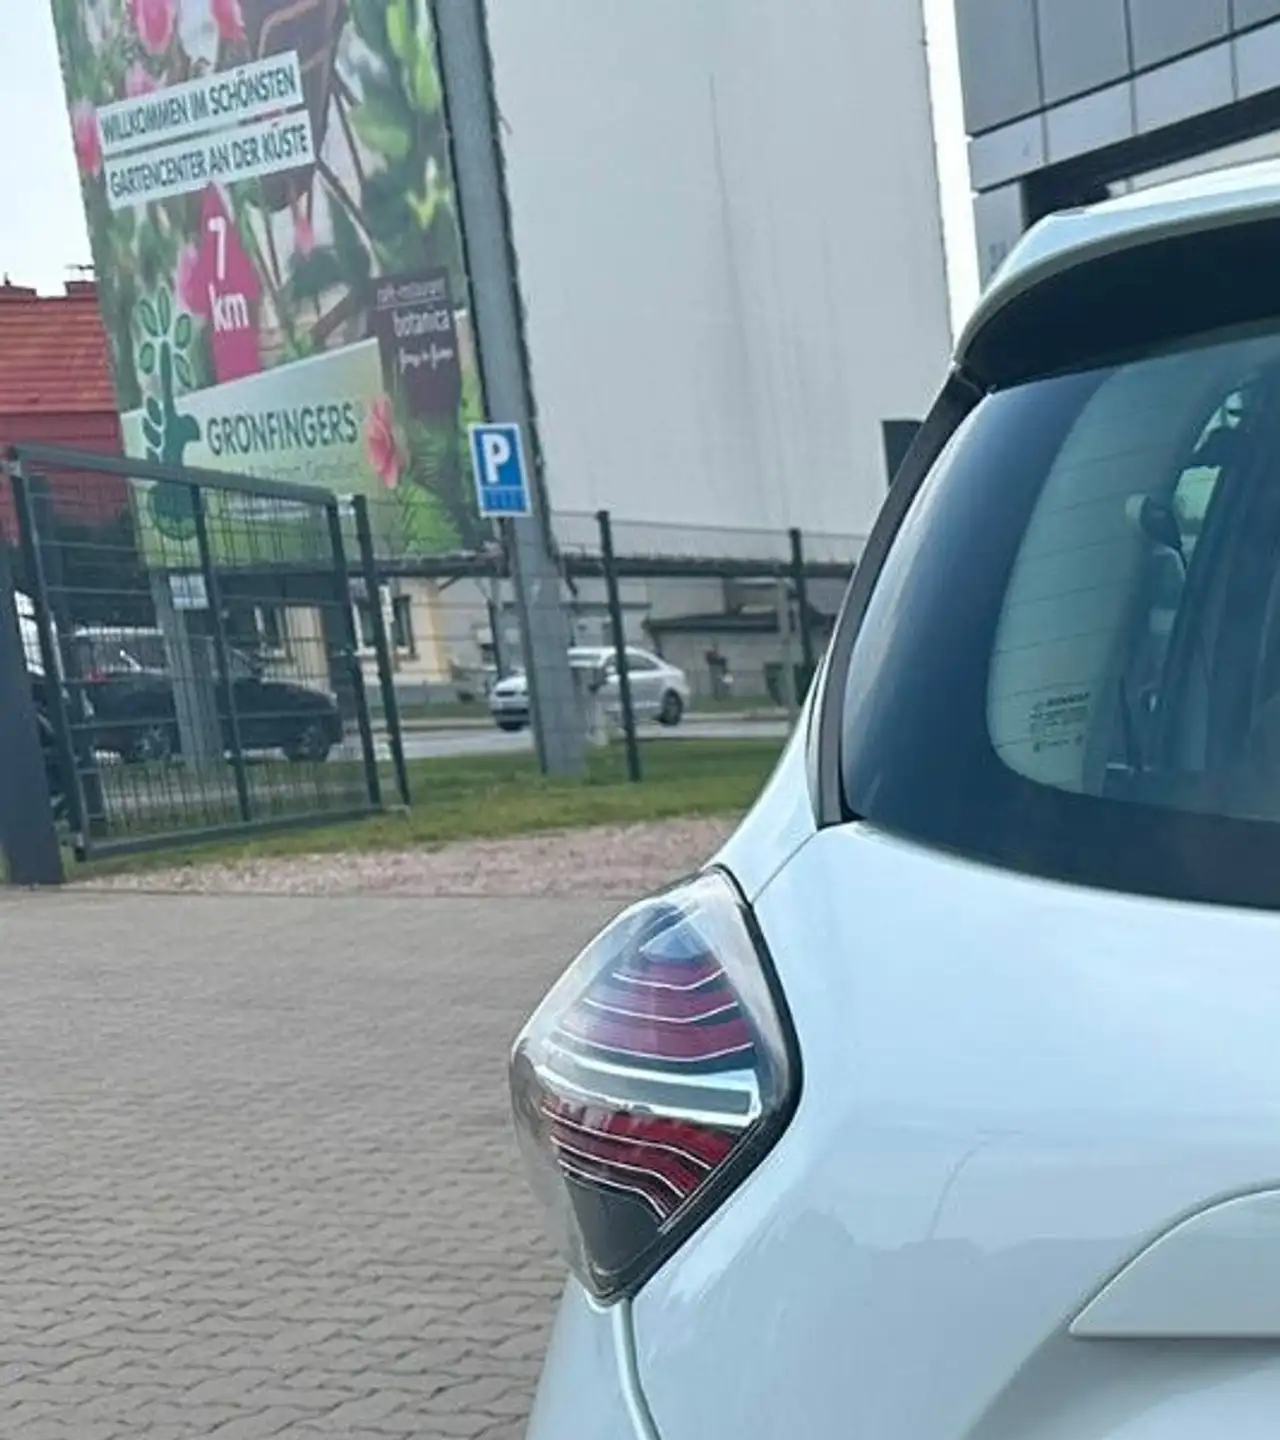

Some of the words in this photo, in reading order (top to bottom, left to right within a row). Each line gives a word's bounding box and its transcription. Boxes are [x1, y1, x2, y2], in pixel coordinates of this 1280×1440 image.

[102, 93, 189, 144] WILLKOMMEN
[190, 90, 209, 121] IM
[209, 65, 297, 115] SCHÖNSTEN
[109, 150, 206, 197] GARTENCENTER
[207, 143, 232, 174] AN
[231, 136, 260, 168] DER
[261, 122, 308, 162] KÜSTE
[208, 216, 227, 280] 7
[209, 282, 249, 332] km
[481, 433, 511, 483] P
